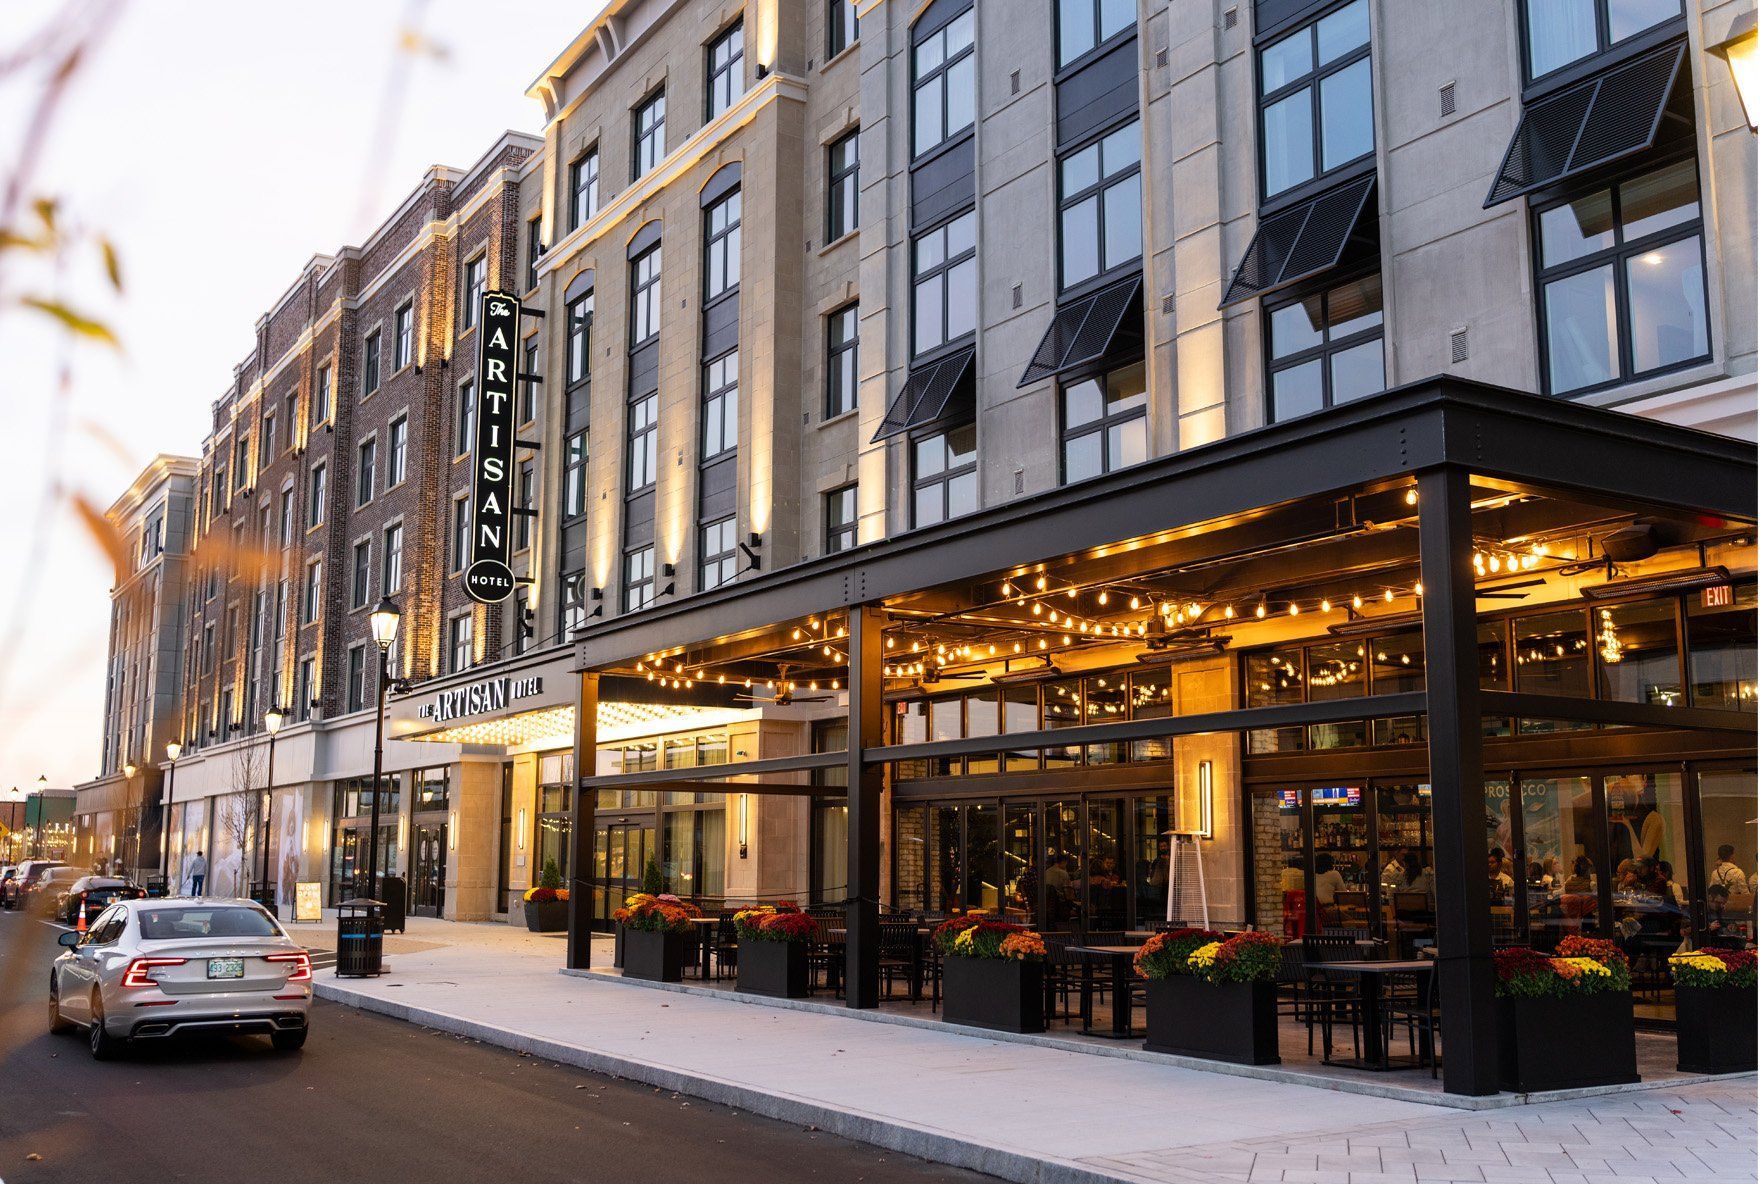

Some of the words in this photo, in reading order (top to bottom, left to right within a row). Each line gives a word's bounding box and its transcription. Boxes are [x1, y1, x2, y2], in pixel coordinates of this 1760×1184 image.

[490, 301, 510, 317] The
[481, 326, 509, 549] ARTISAN
[471, 575, 509, 588] HOTEL
[1706, 585, 1729, 606] EXIT
[432, 677, 508, 722] ARTISAN
[511, 676, 539, 699] HOTEL
[1485, 783, 1546, 798] ROSCO
